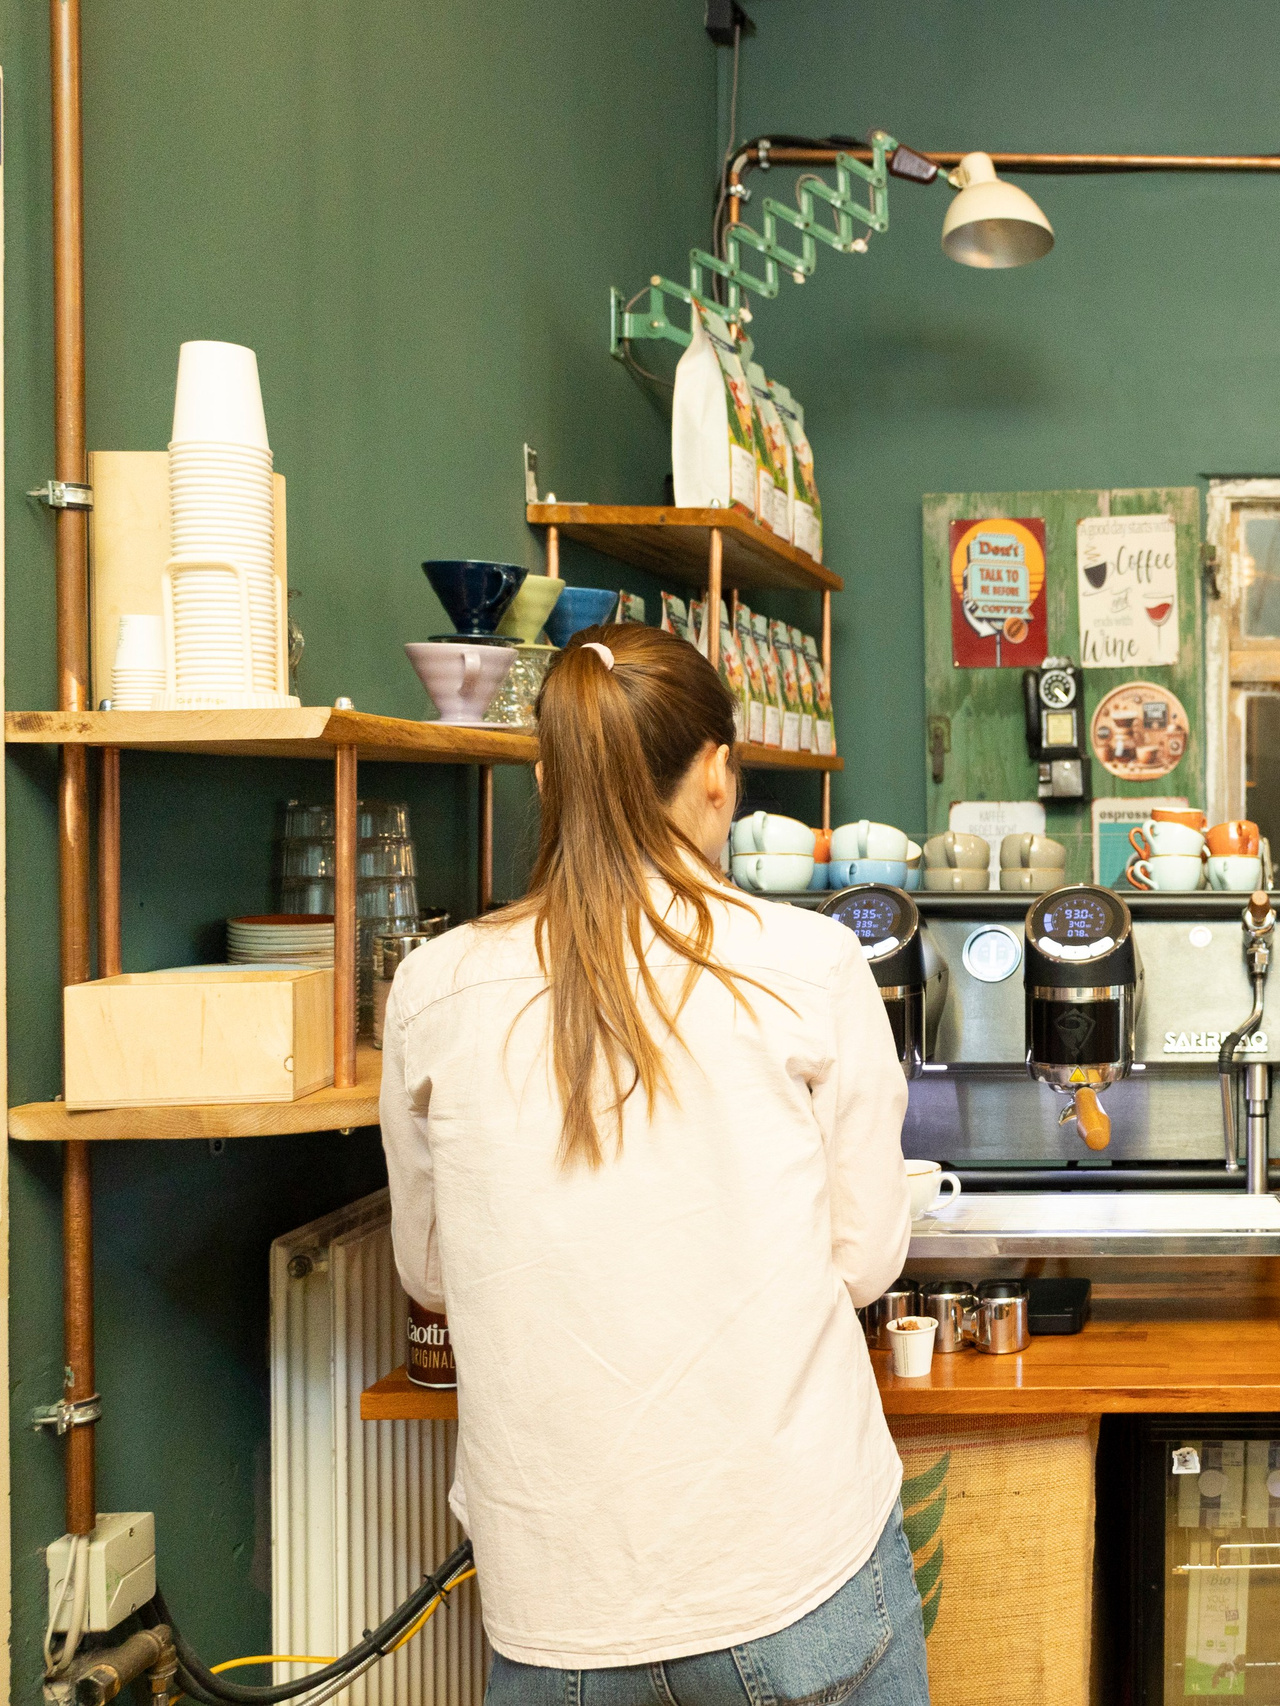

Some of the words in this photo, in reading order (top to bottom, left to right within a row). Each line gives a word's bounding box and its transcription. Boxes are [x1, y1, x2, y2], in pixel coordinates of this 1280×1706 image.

[1116, 545, 1174, 584] Coffee
[979, 567, 1003, 582] TALK
[1006, 569, 1019, 583] TO
[981, 604, 1024, 615] COFFEE
[1083, 629, 1139, 663] Wine
[1099, 811, 1152, 823] espress
[411, 1346, 456, 1369] ORIGINAL
